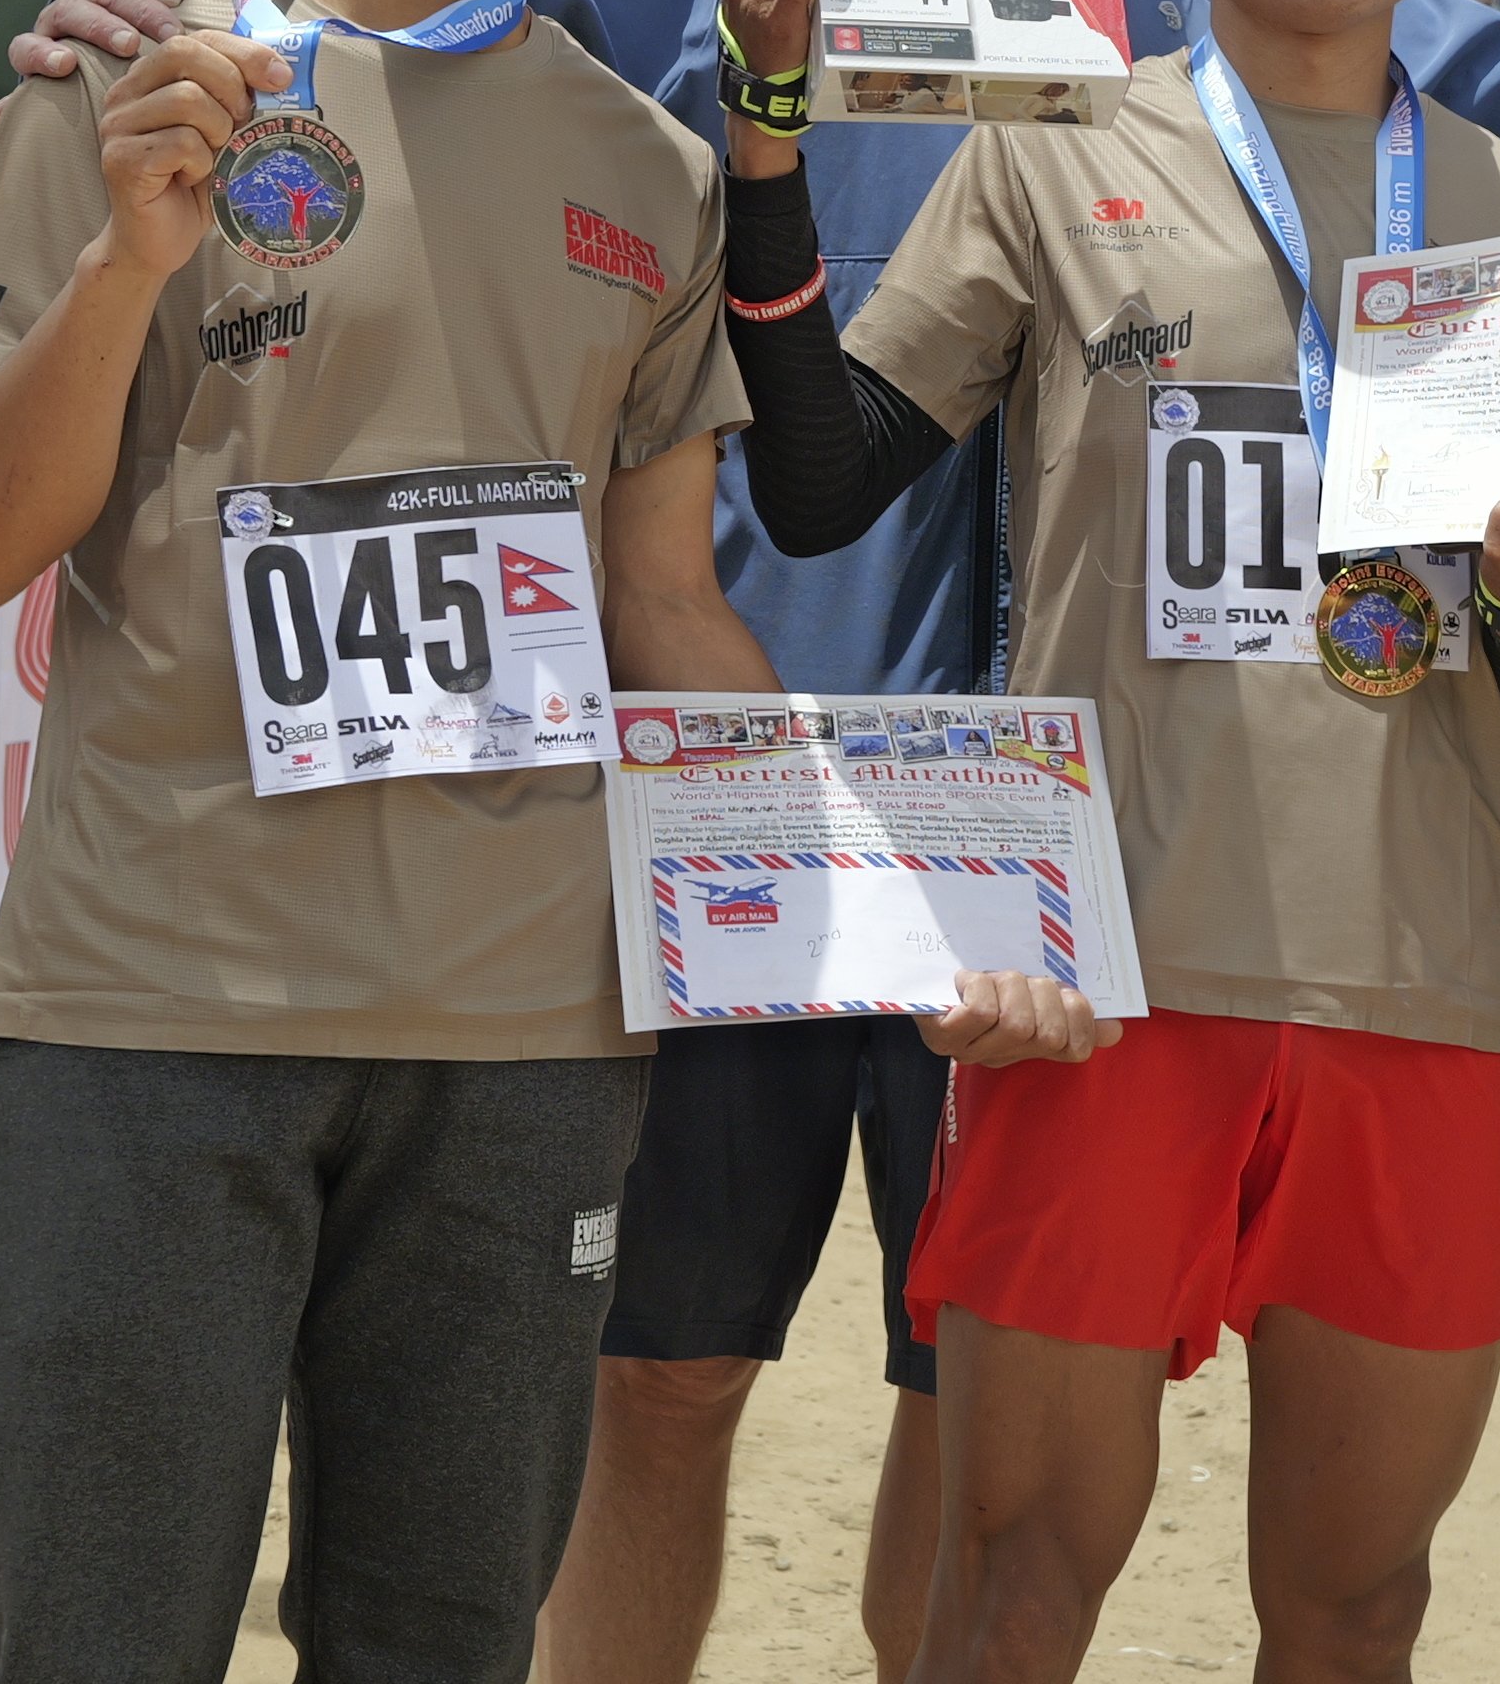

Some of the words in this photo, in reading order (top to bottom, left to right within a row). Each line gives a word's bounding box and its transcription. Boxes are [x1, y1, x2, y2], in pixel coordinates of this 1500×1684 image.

[441, 0, 514, 47] Marathon
[228, 118, 285, 154] Mount
[291, 117, 356, 166] Everest
[1091, 197, 1145, 222] 3M
[564, 206, 660, 270] EVEREST
[1089, 240, 1144, 253] Insulation
[239, 236, 342, 268] MARATHON
[566, 236, 666, 296] MARATHON
[599, 274, 631, 289] Highest
[269, 346, 291, 359] 3M
[1081, 309, 1193, 388] Scotchgard
[1447, 341, 1495, 351] Highest
[1158, 357, 1177, 369] 3M
[1406, 368, 1436, 376] NEPAL
[386, 485, 473, 513] 42K-FULL
[476, 478, 571, 505] MARATHON
[1166, 437, 1334, 592] 01
[1426, 552, 1457, 567] KULUNG
[244, 528, 493, 706] 045
[1162, 599, 1216, 629] Seara
[1225, 608, 1290, 624] SILVA
[1182, 632, 1201, 643] 3M
[264, 720, 328, 754] Seara
[337, 715, 410, 736] SILVA
[291, 753, 313, 765] 3M
[679, 765, 835, 783] Everest
[850, 763, 1041, 786] Marathon
[670, 791, 723, 801] World's
[726, 790, 779, 800] Highest
[783, 789, 813, 798] Trail
[817, 789, 874, 799] Running
[877, 789, 947, 799] Marathon
[946, 791, 1005, 801] SPORTS
[1009, 793, 1046, 803] Event
[786, 802, 818, 812] Gopal
[906, 802, 946, 810] SECOND
[712, 914, 726, 922] BY
[728, 914, 747, 922] AIR
[749, 913, 774, 921] MAIL
[906, 931, 952, 954] 42K
